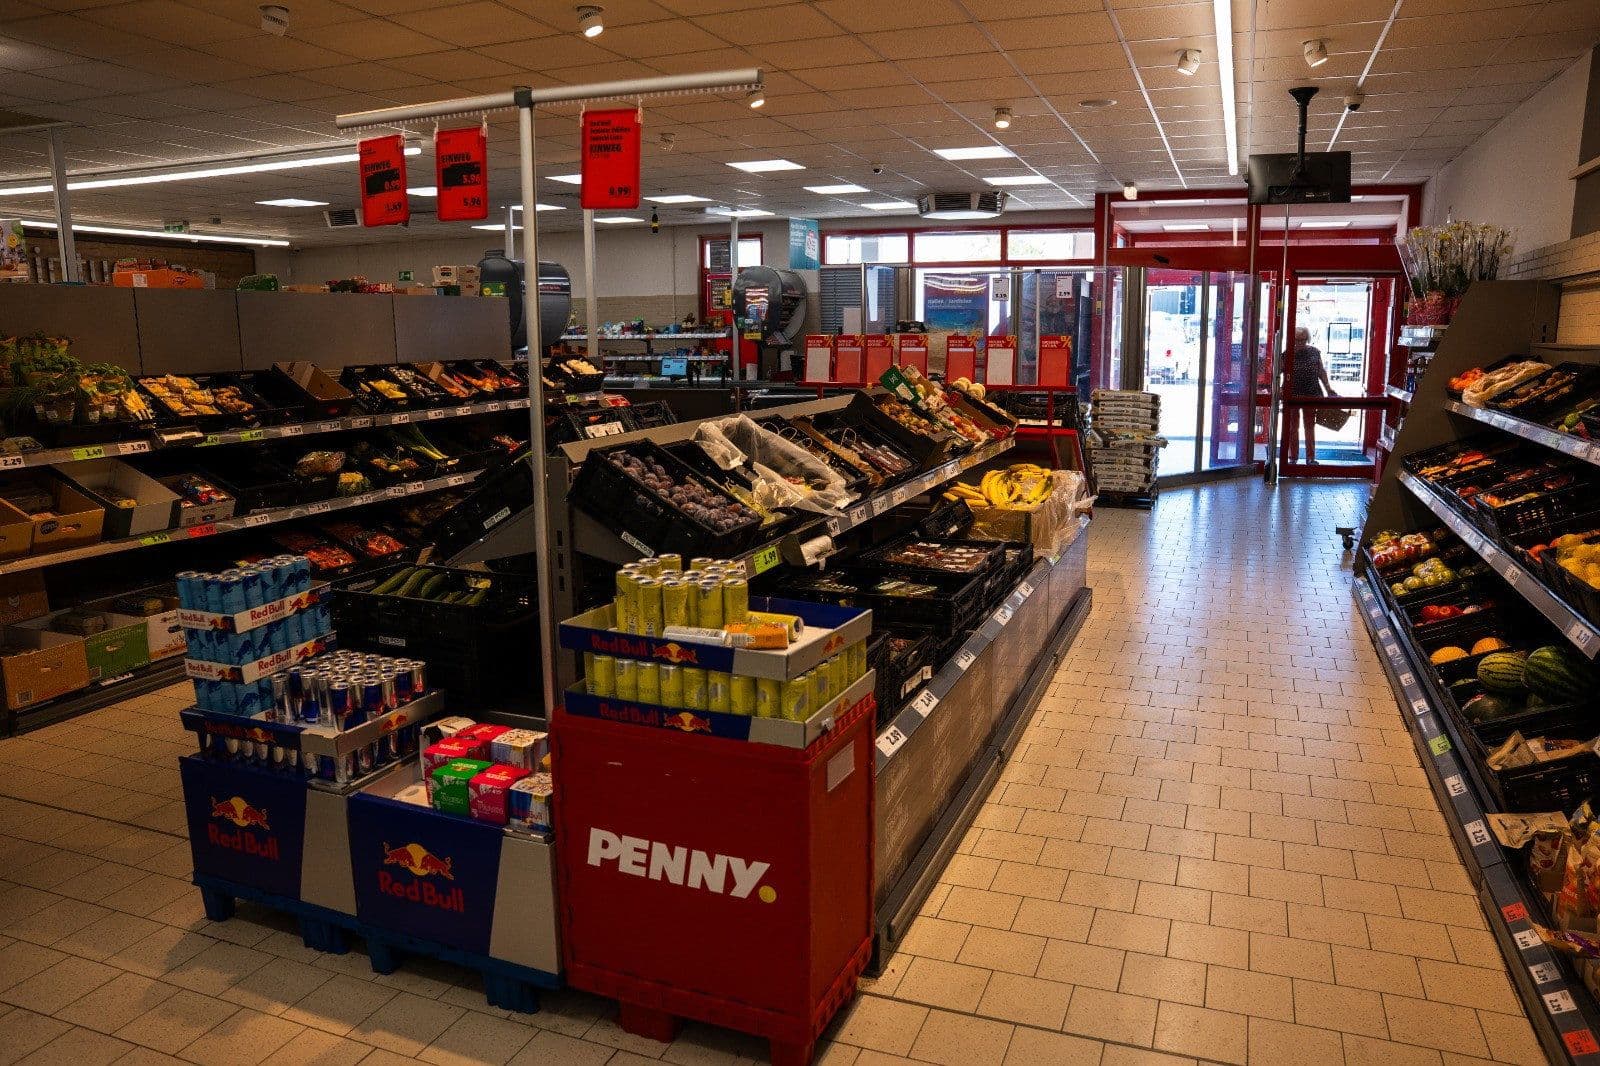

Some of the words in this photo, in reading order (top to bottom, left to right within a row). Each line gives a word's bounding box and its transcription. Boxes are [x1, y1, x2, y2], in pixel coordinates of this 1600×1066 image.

[250, 607, 267, 621] Red
[268, 600, 285, 616] Bull
[257, 658, 275, 672] Red
[275, 650, 292, 666] Bull
[207, 823, 242, 854] Red
[243, 831, 280, 864] Bull
[377, 870, 419, 903] Red
[422, 880, 464, 912] Bull
